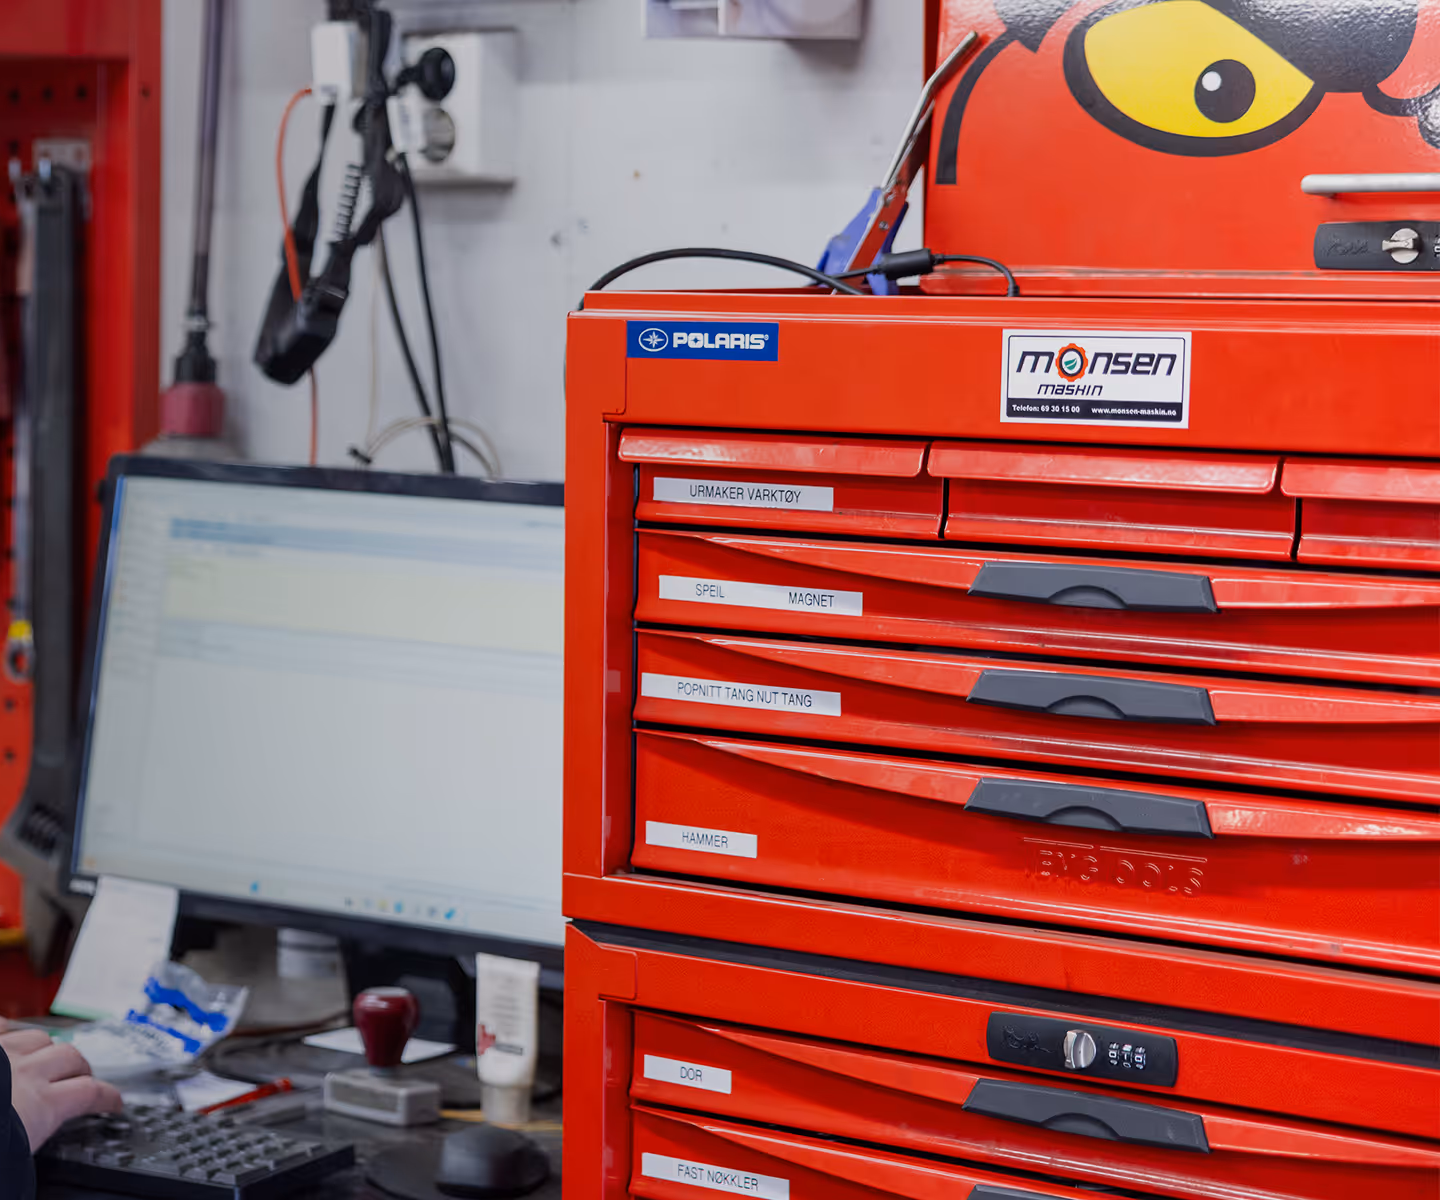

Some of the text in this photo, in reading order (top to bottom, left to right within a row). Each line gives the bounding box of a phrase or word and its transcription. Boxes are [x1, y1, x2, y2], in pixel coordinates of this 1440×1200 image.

[1011, 404, 1177, 416] Telefon: 69 30 15 00 www.monsen-maskin.no
[689, 484, 802, 503] URMAKER VARKTØY
[695, 583, 835, 607] SPEIL MAGNET
[677, 681, 812, 708] POPNITT TANG NUT TANG
[682, 831, 729, 848] HAMMER
[680, 1066, 703, 1082] DOR
[677, 1163, 759, 1192] FAST NØKKLER
